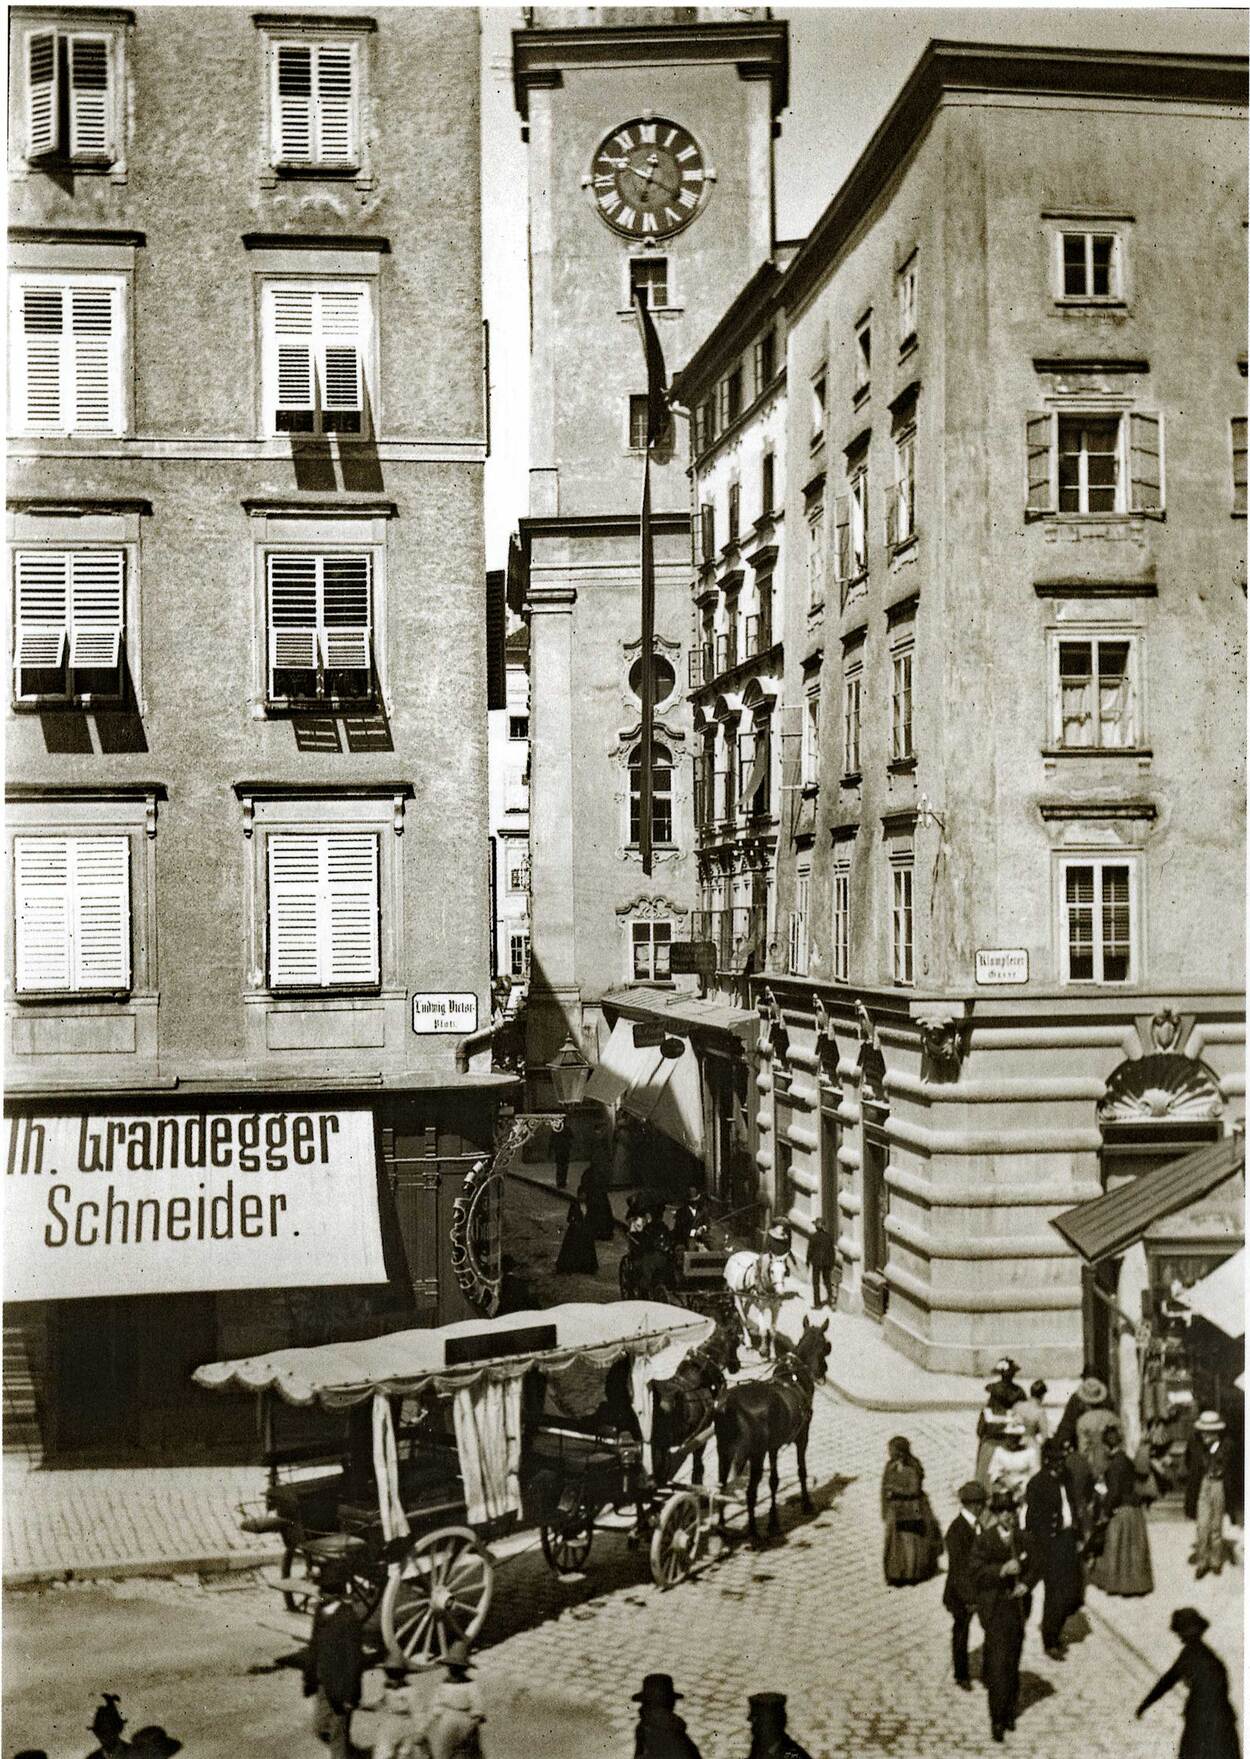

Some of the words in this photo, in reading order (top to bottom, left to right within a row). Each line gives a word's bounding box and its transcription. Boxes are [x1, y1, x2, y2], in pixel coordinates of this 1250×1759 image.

[415, 999, 446, 1016] Ludwig
[77, 1111, 340, 1173] Grandegger
[44, 1179, 301, 1248] Schneider.
